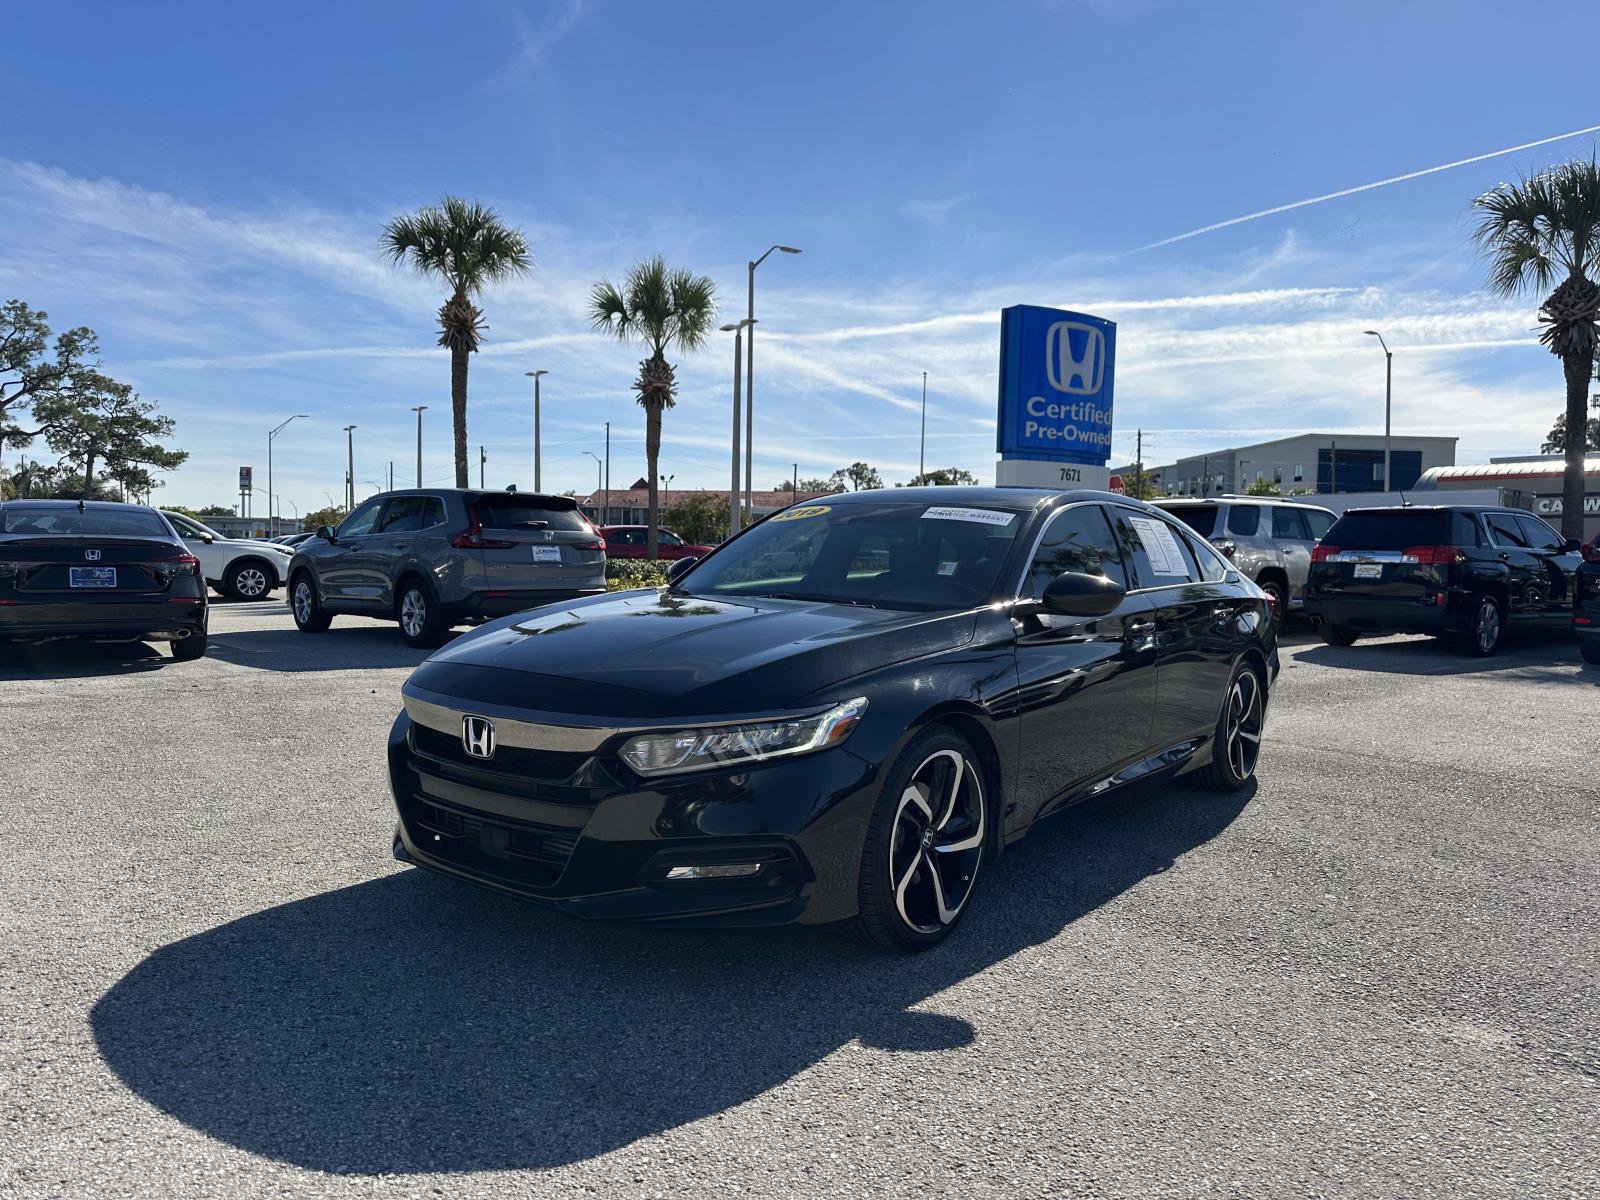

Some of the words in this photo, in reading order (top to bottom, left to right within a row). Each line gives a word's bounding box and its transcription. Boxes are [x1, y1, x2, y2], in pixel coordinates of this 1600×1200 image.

[1027, 396, 1112, 426] Certified
[1025, 421, 1111, 445] Pre-Owned
[1060, 468, 1080, 482] 7671
[1538, 500, 1563, 512] CA
